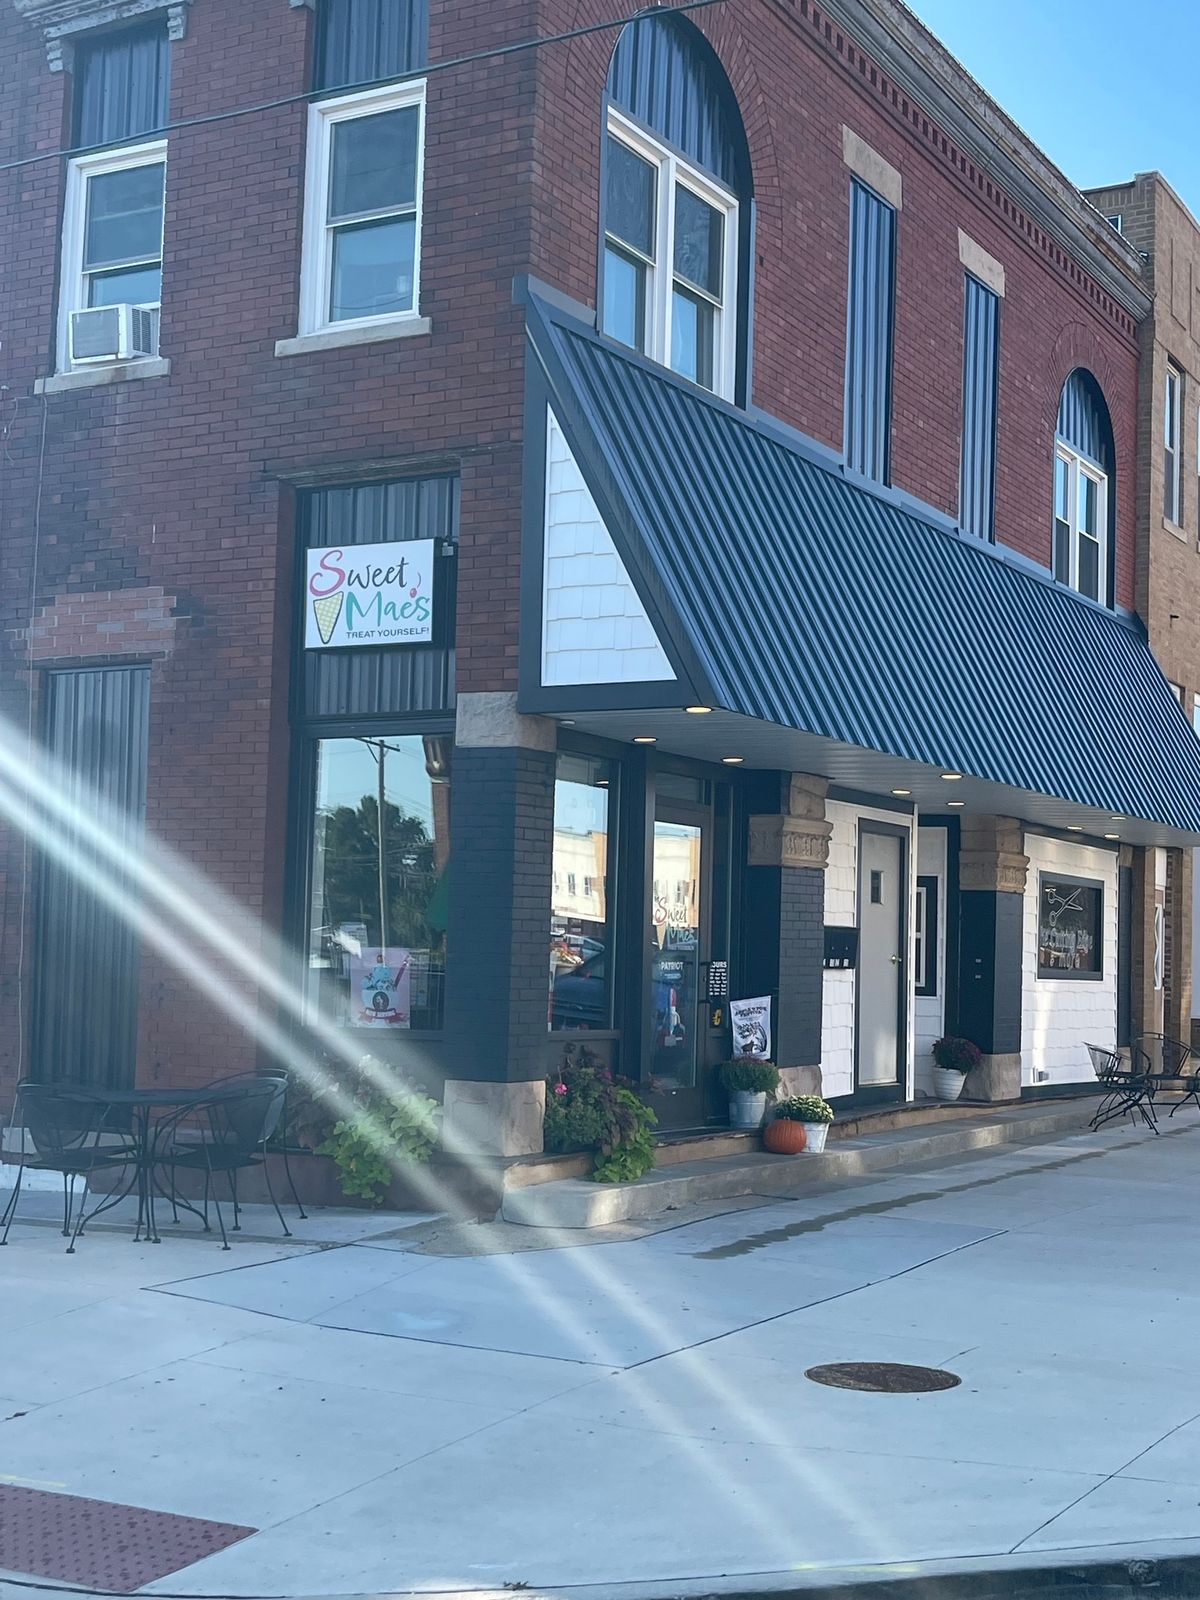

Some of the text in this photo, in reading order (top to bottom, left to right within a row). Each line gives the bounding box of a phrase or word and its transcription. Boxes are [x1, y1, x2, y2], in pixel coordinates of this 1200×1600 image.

[309, 549, 409, 597] Sweet
[346, 626, 430, 639] TREAT YOURSELF!
[655, 896, 687, 925] Sweet
